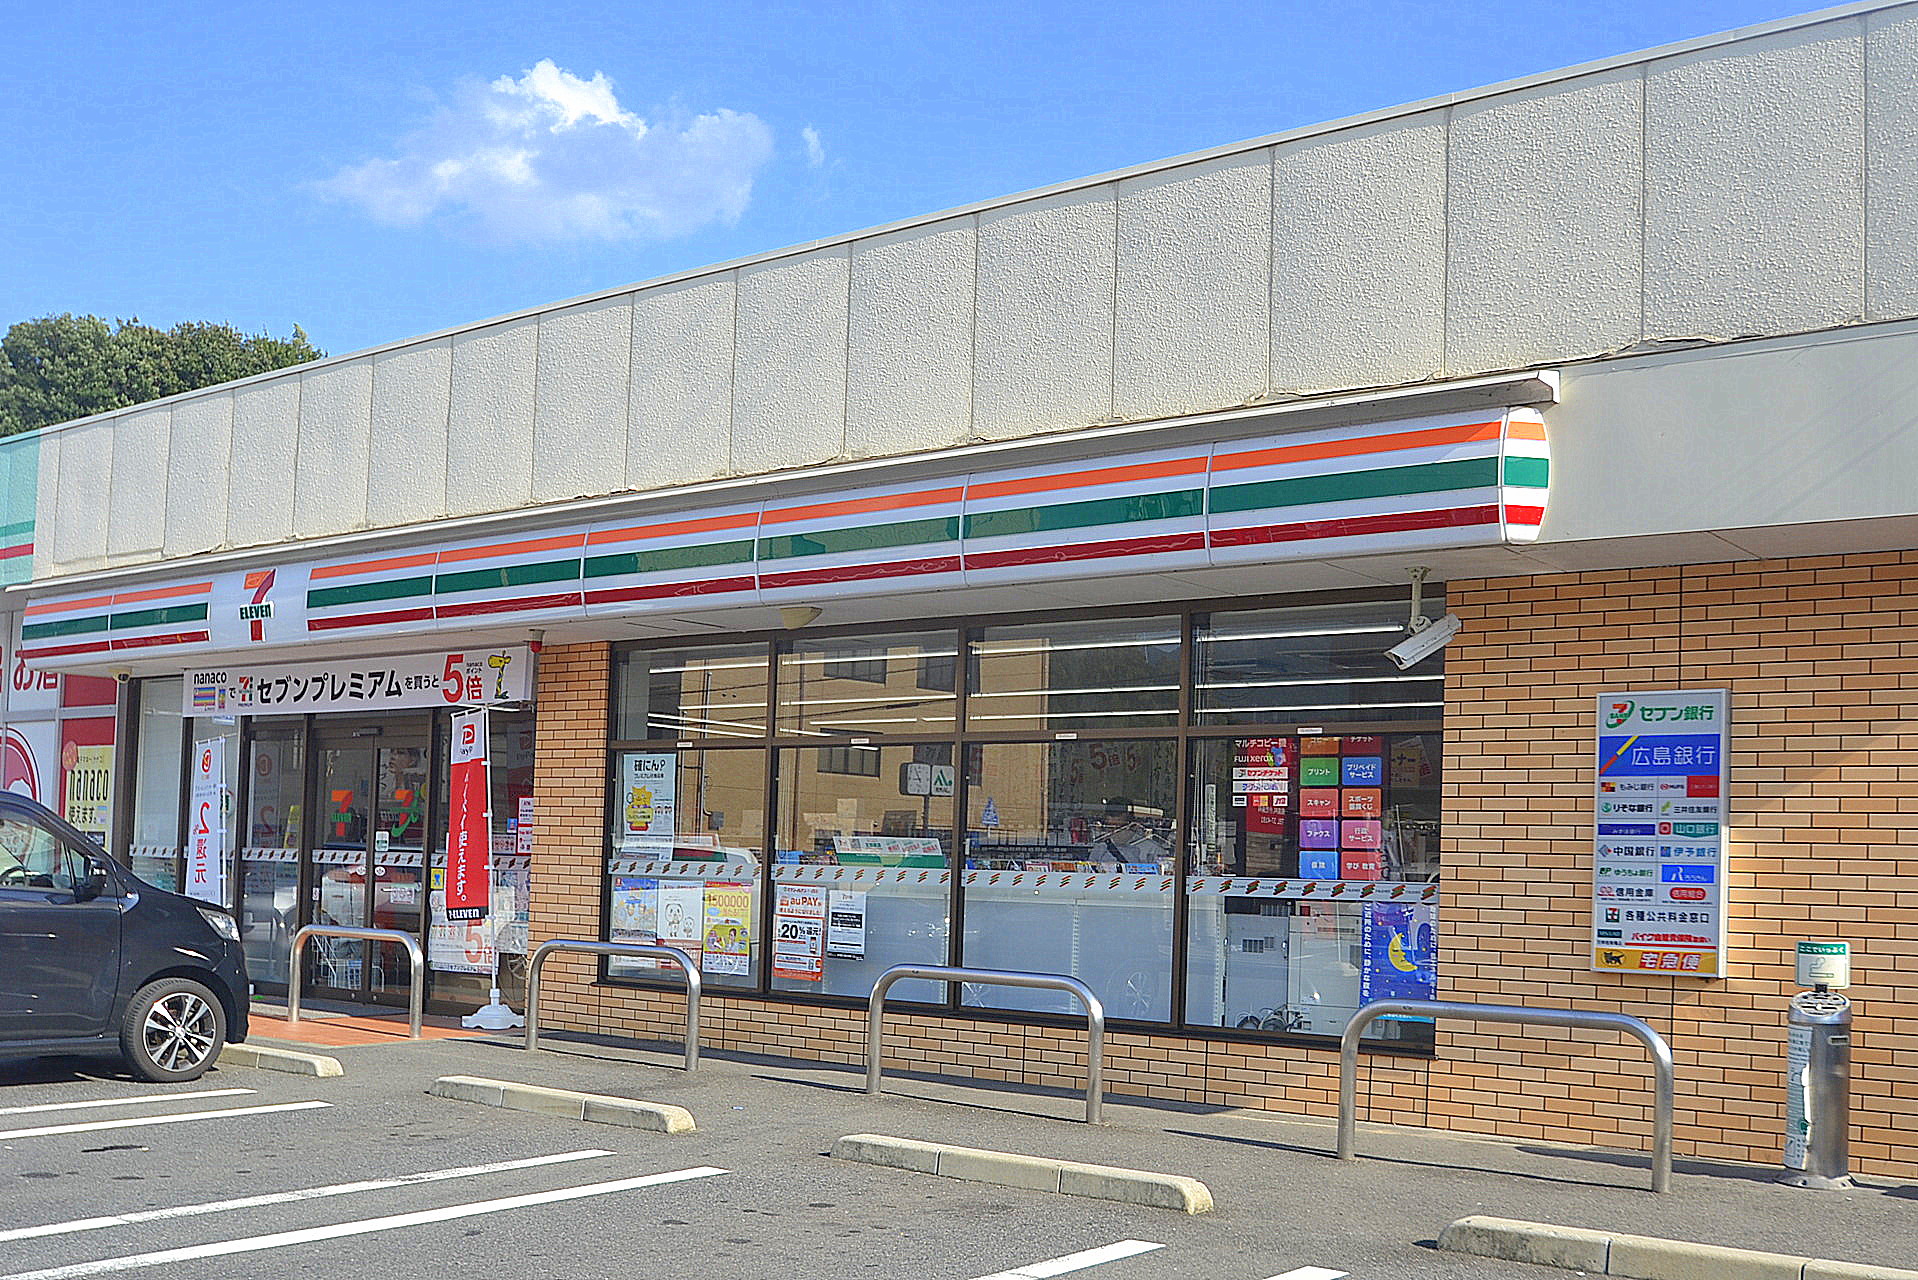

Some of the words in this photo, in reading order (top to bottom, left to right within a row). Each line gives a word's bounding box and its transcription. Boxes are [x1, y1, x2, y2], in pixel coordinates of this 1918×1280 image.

[244, 568, 276, 641] 7
[193, 671, 227, 685] nanaco
[229, 687, 237, 699] で
[1639, 705, 1715, 722] セブン銀行
[1631, 745, 1716, 766] 広島銀行
[1307, 768, 1332, 776] プリント
[1349, 771, 1375, 779] サービス
[69, 769, 109, 801] nanaco
[1307, 799, 1332, 807] スキャン
[1612, 803, 1654, 813] りそな銀行
[1673, 805, 1718, 814] 三井住友銀行
[1306, 830, 1331, 838] ファクス
[1675, 824, 1716, 834] 山口銀行
[1349, 834, 1374, 842] サービス
[1613, 846, 1655, 857] 中国銀行
[1673, 847, 1718, 858] 伊予銀行
[1615, 887, 1654, 897] 信用金庫
[1625, 910, 1710, 924] 各種公共料金窓口
[1640, 952, 1702, 970] 宅急便
